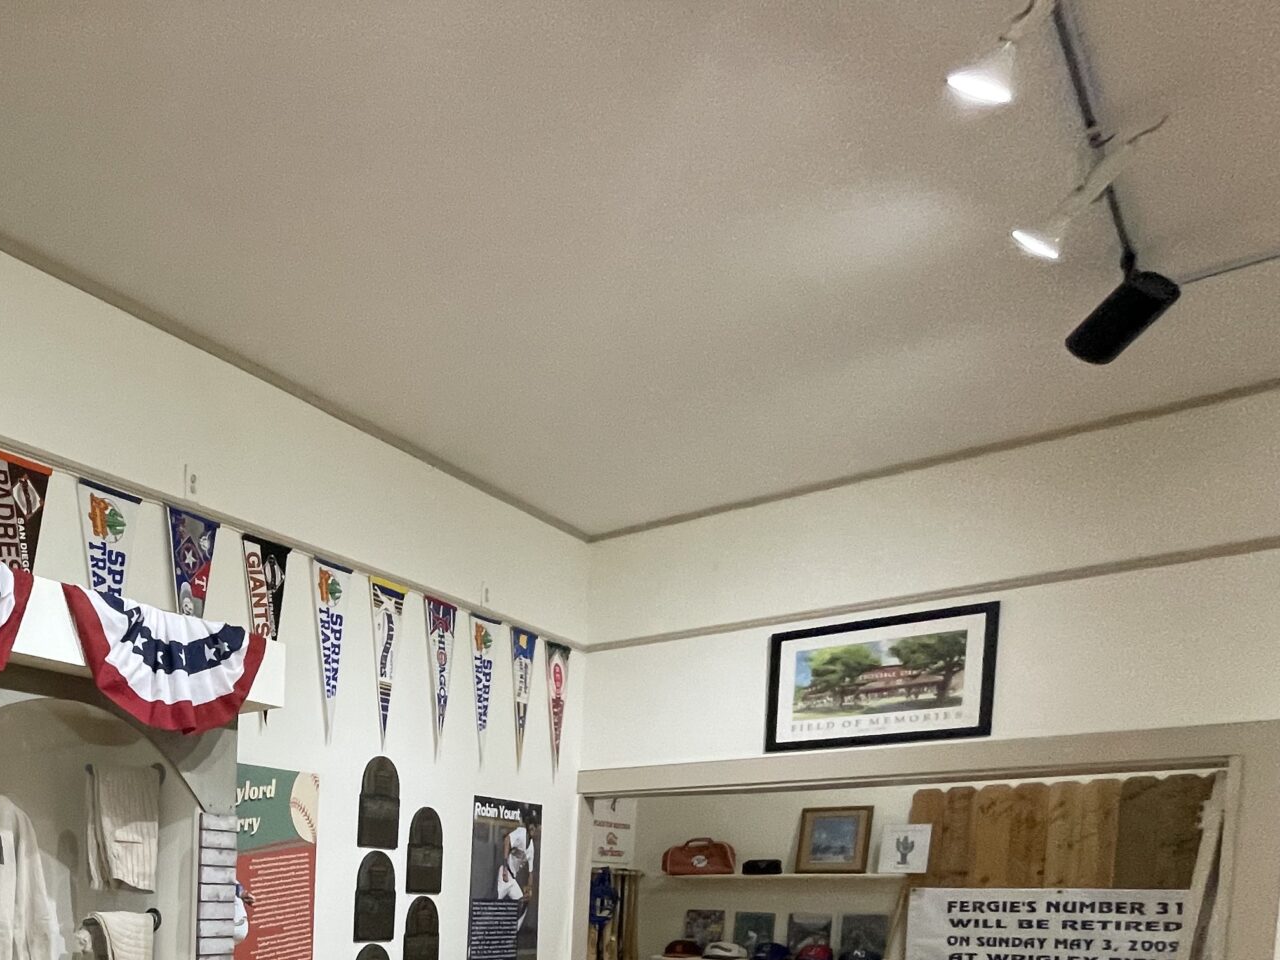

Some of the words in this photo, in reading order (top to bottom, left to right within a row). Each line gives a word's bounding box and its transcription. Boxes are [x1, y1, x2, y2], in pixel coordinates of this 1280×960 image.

[17, 517, 26, 540] SAN
[246, 551, 270, 638] GIANTS
[319, 607, 332, 699] TRAINING
[330, 612, 344, 697] SPRING
[790, 720, 835, 733] FIELD
[841, 718, 864, 730] OF
[869, 710, 964, 727] MEMORIES
[474, 802, 498, 818] Robin
[499, 805, 521, 821] Yount
[946, 900, 1037, 914] FERGIE'S
[1045, 901, 1146, 915] NUMBER
[1156, 902, 1184, 915] 31
[949, 918, 1008, 929] WILL
[1017, 919, 1049, 930] BE
[1061, 919, 1183, 932] RETIRED
[946, 935, 970, 947] ON
[976, 936, 1046, 949] SUNDAY
[1053, 938, 1093, 950] MAY
[1102, 939, 1119, 952] 3,
